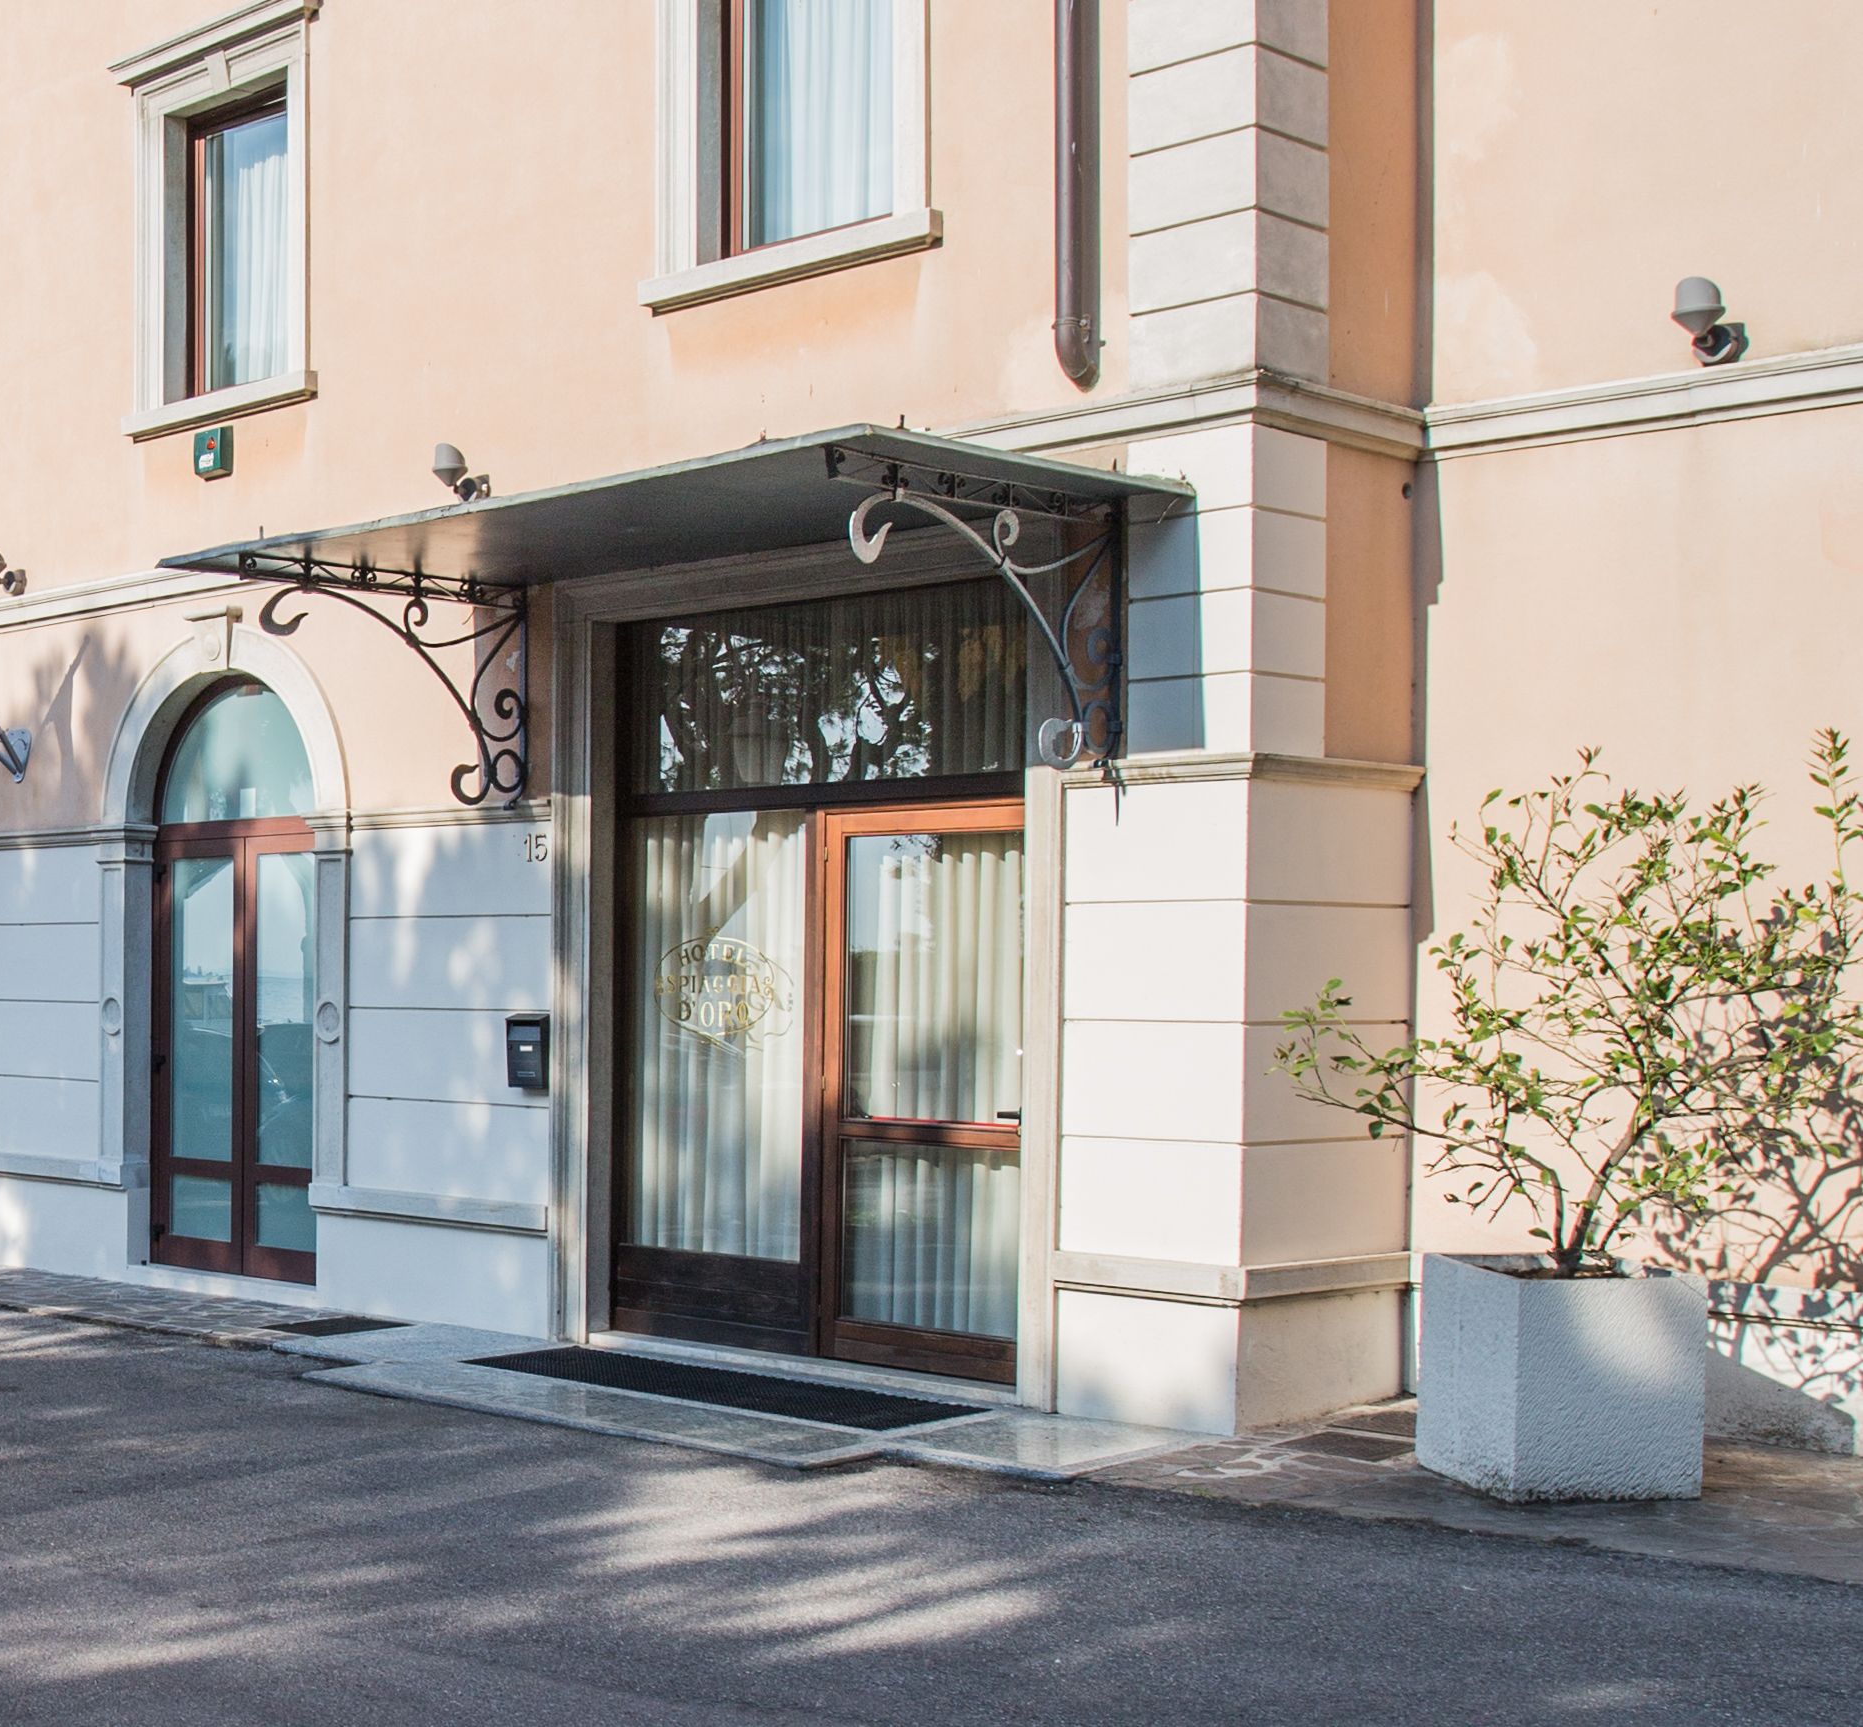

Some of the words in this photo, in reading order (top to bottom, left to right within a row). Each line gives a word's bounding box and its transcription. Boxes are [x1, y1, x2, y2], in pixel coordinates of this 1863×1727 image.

[523, 832, 548, 863] 15
[677, 943, 748, 967] HOTEL
[666, 974, 762, 994] SPIAGGIA
[677, 1000, 750, 1028] D'ORO
